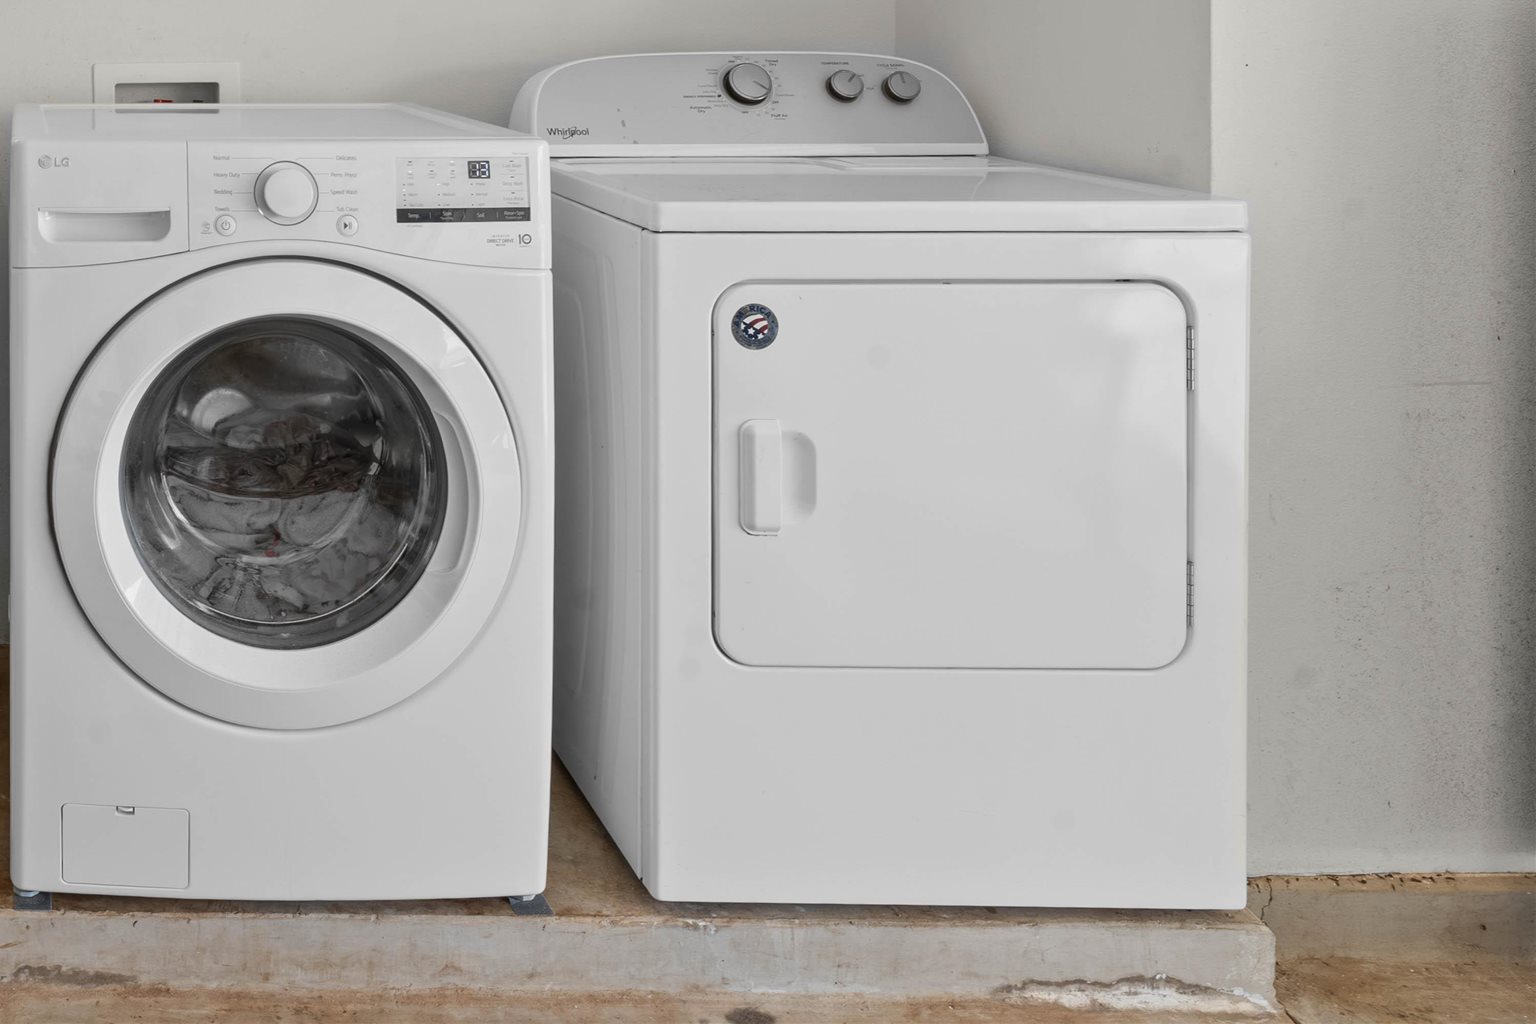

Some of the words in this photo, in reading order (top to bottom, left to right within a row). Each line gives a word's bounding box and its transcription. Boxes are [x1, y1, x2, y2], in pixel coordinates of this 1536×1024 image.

[546, 126, 589, 140] Whirlpool
[54, 157, 70, 167] LG
[734, 305, 771, 327] AMRICA
